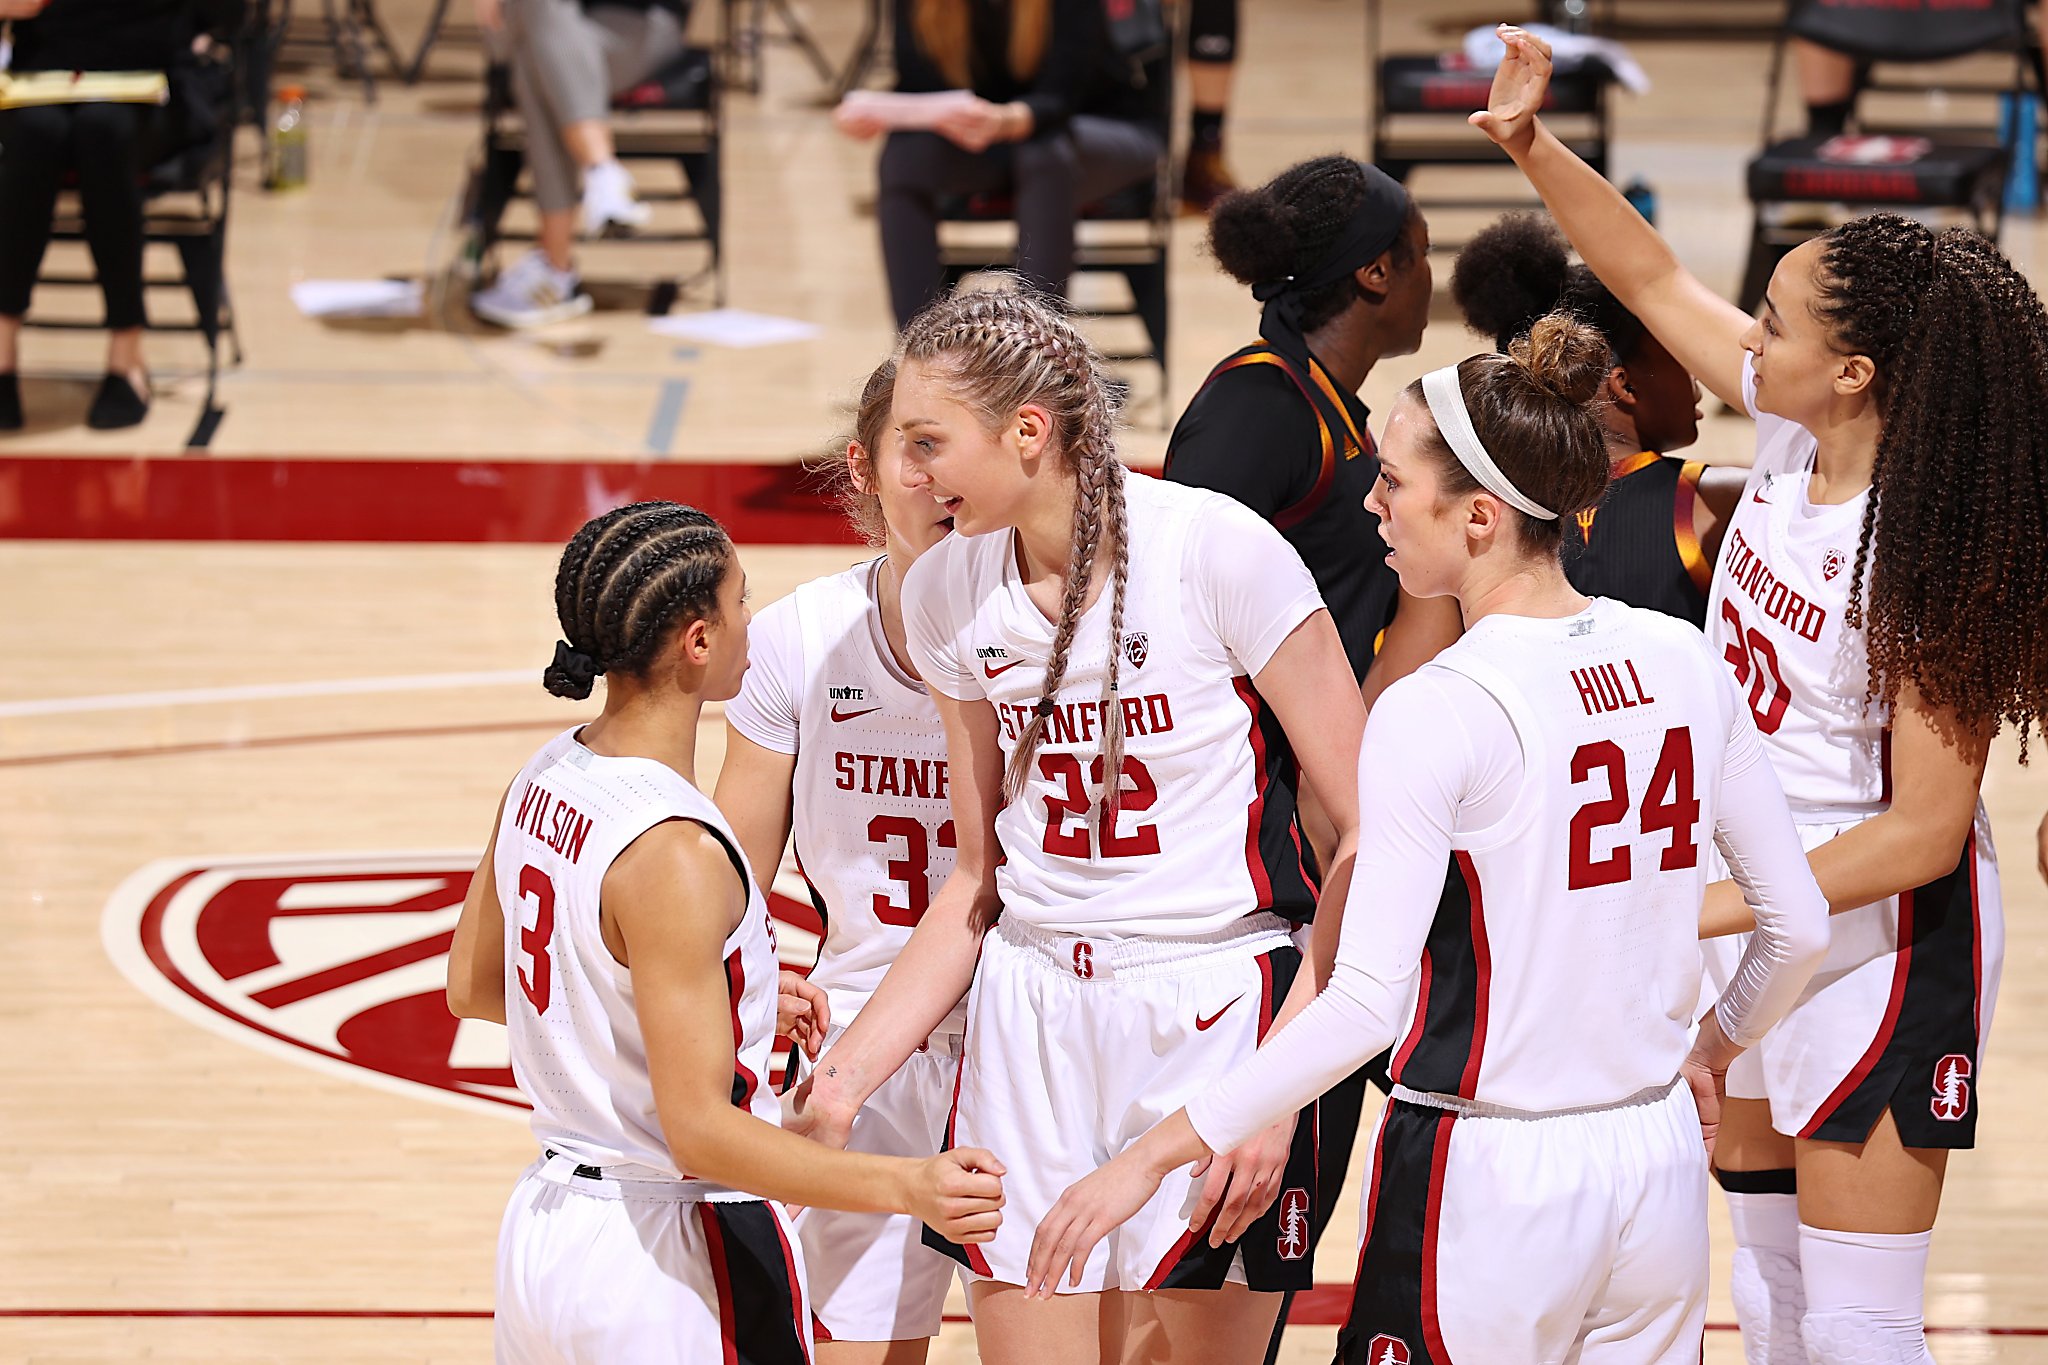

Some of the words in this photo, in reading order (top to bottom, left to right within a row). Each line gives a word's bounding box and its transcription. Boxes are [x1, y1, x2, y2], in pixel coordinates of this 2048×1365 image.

[1726, 528, 1826, 643] STANFORD
[1123, 632, 1148, 657] PAC
[1131, 647, 1144, 663] 12
[1570, 659, 1654, 715] HULL
[835, 751, 949, 799] STANF
[1038, 753, 1161, 859] 22
[1568, 726, 1700, 890] 24
[515, 779, 593, 865] WILSON
[516, 863, 556, 1017] 3
